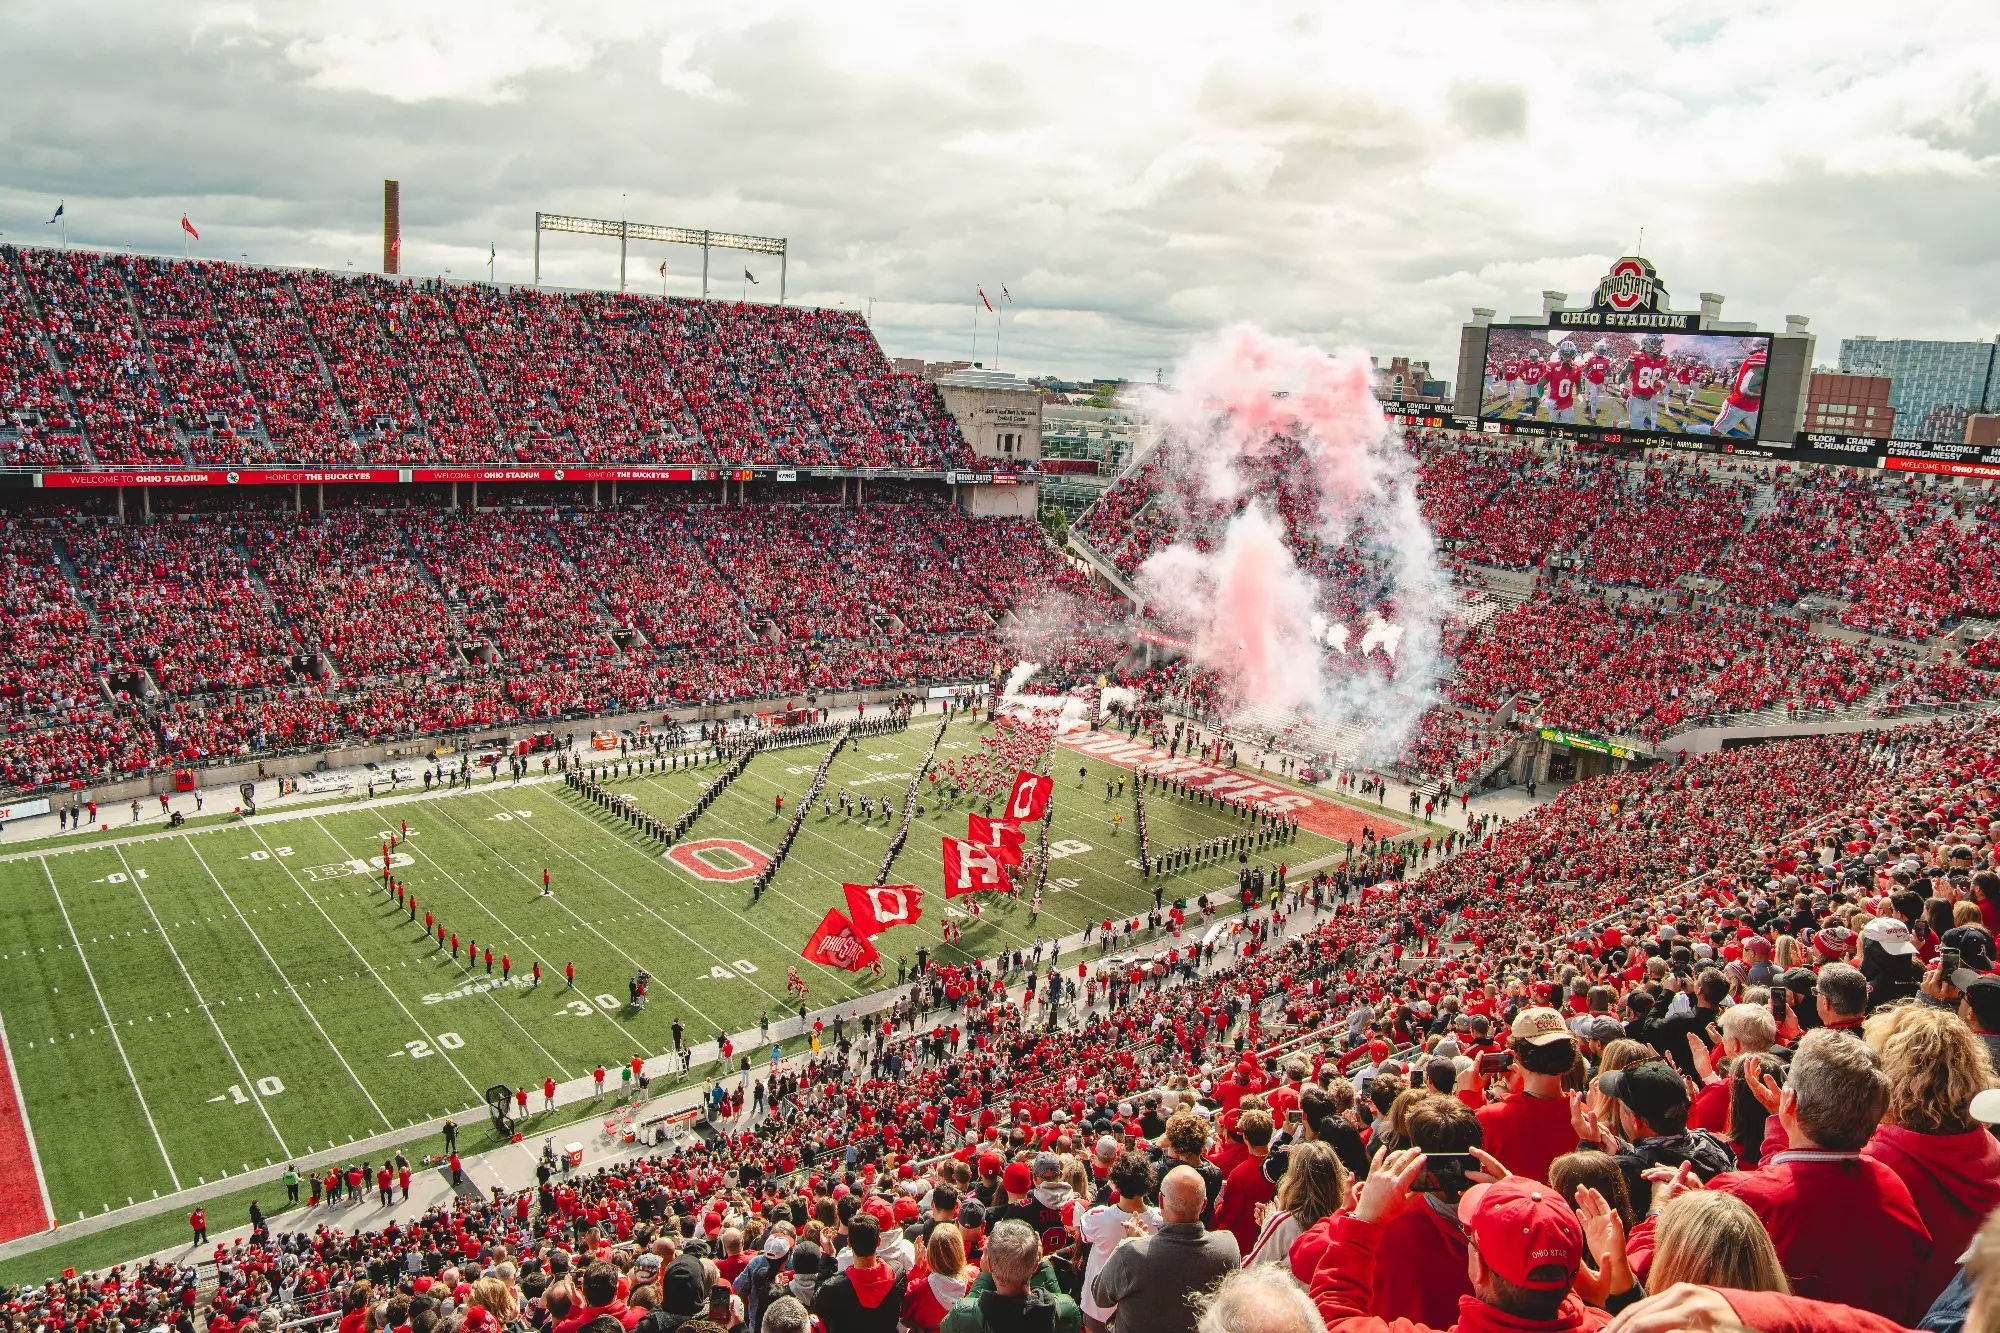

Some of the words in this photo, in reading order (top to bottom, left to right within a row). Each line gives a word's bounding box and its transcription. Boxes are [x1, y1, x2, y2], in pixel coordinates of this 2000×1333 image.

[1561, 313, 1600, 325] OHIO
[1605, 313, 1687, 328] STADIUM
[1528, 367, 1539, 379] 17
[1638, 367, 1662, 389] 88
[1558, 379, 1571, 398] 0
[1406, 402, 1431, 410] COVELLI
[1604, 434, 1621, 443] 6:33
[1808, 434, 1836, 443] BLOCH
[1846, 437, 1876, 446] CRANE
[1813, 442, 1868, 452] SCHUMAKER
[1887, 440, 1922, 450] PHIPPS
[1933, 444, 1980, 454] McCORKLE
[1888, 448, 1962, 460] O'SHAUGHNESSY
[1900, 461, 1939, 470] WELCOME
[1952, 465, 1973, 473] OHIO
[70, 475, 119, 484] WELCOME
[121, 475, 134, 483] TO
[135, 475, 162, 483] OHIO
[163, 474, 209, 482] STADIUM
[324, 472, 371, 480] BUCKEYES
[948, 686, 969, 696] meijer
[250, 846, 296, 860] 20
[957, 841, 1001, 888] H
[106, 868, 149, 883] 10
[711, 959, 758, 980] 40
[567, 993, 622, 1017] 30
[405, 1032, 465, 1059] 20
[228, 1076, 285, 1105] 10
[573, 1152, 581, 1160] G
[1532, 1249, 1549, 1259] OHIO
